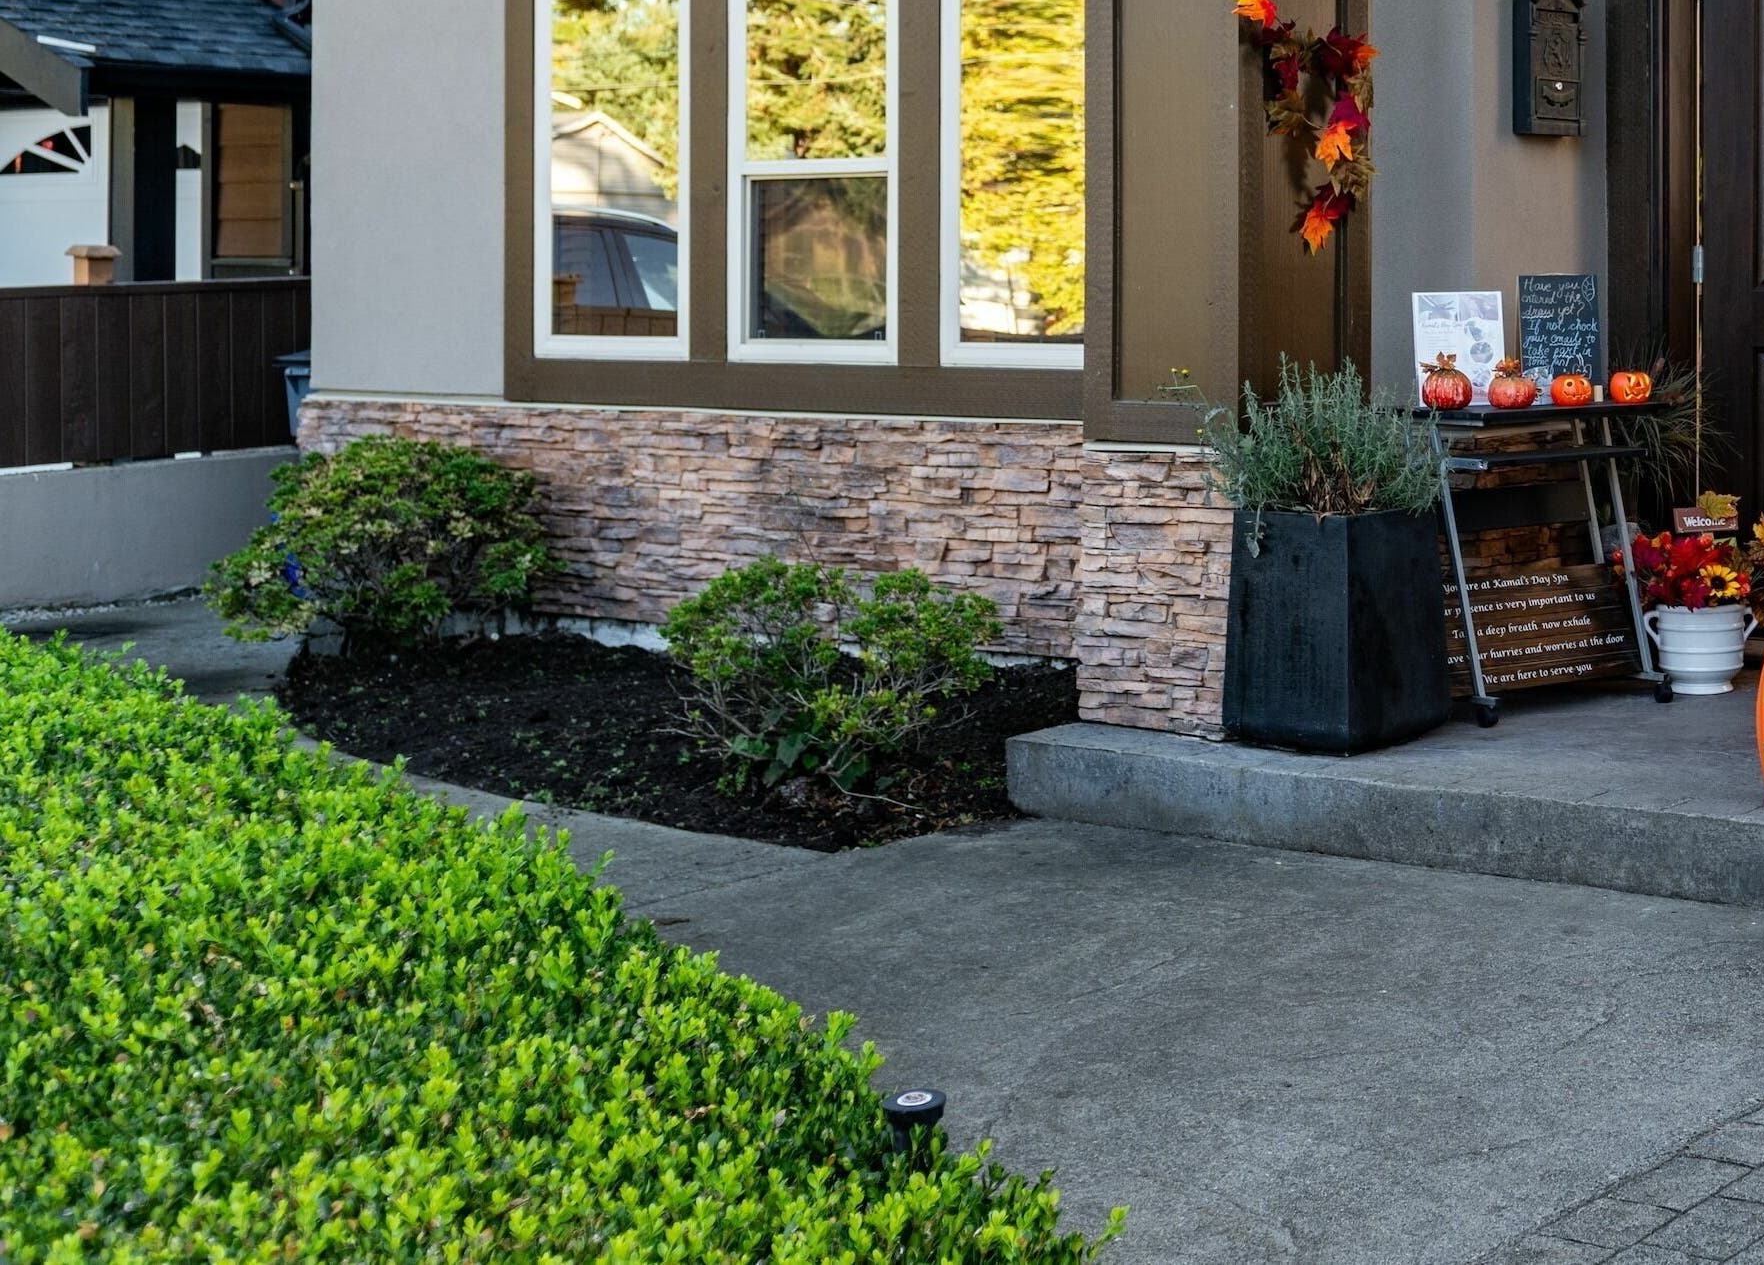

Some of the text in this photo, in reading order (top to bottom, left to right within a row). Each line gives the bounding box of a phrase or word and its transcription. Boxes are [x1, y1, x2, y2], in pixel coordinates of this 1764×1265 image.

[1523, 276, 1580, 298] Have you
[1521, 291, 1581, 304] entered the
[1522, 305, 1554, 317] draw
[1527, 318, 1541, 335] If
[1568, 317, 1599, 333] check
[1522, 334, 1548, 348] your
[1585, 333, 1596, 344] to
[1527, 343, 1593, 359] take part in
[1527, 356, 1549, 367] some
[1683, 516, 1726, 527] Welcome
[1481, 581, 1491, 590] at
[1492, 575, 1529, 589] Kamal's
[1530, 575, 1551, 586] Day
[1552, 574, 1569, 585] Spa
[1454, 604, 1494, 618] psence
[1496, 601, 1503, 610] is
[1505, 600, 1526, 611] very
[1528, 594, 1573, 609] important
[1575, 592, 1584, 601] to
[1586, 592, 1596, 600] us
[1485, 624, 1506, 637] deep
[1508, 620, 1538, 633] breath
[1542, 621, 1561, 630] now
[1562, 615, 1591, 628] exhale
[1447, 656, 1465, 665] ave
[1490, 647, 1523, 659] hurries
[1525, 643, 1543, 654] and
[1543, 640, 1577, 652] worries
[1579, 639, 1588, 647] at
[1590, 635, 1603, 646] the
[1605, 634, 1625, 644] door
[1481, 663, 1593, 684] We are here to serve you
